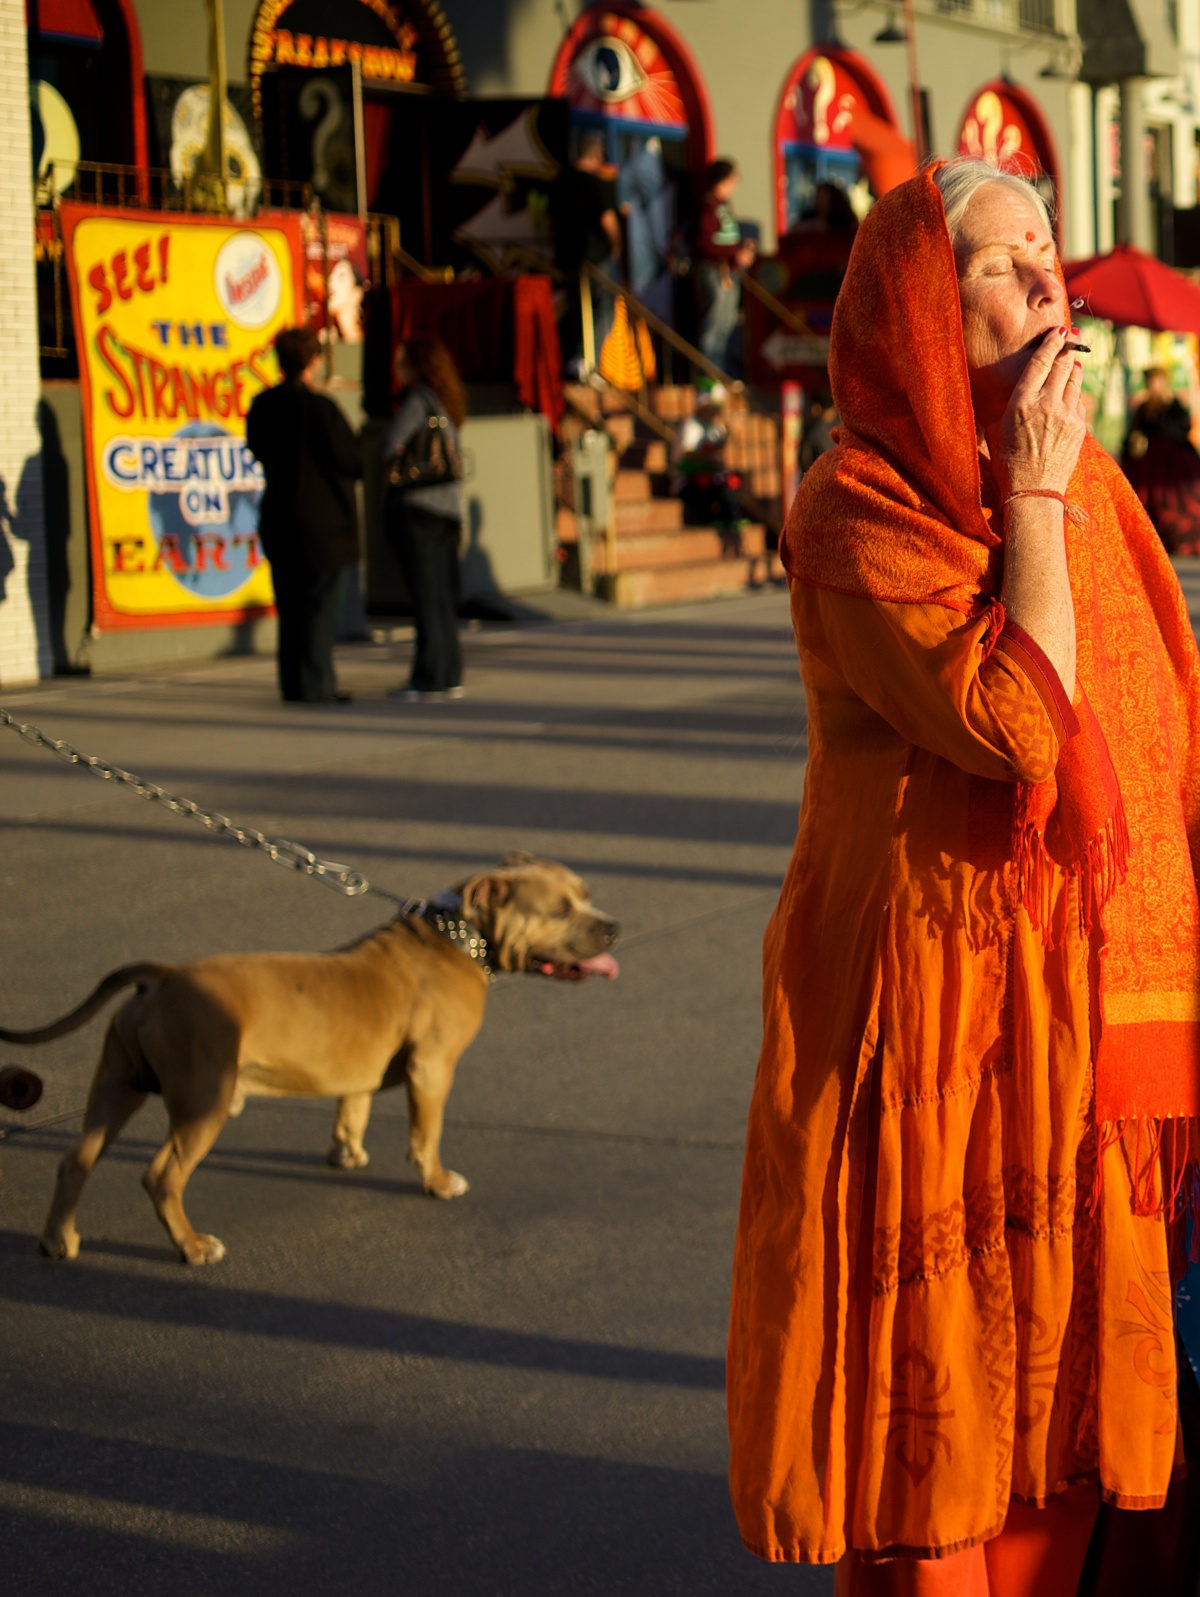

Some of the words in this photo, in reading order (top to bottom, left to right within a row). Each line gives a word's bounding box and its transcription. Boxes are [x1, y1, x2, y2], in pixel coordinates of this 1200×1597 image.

[88, 234, 169, 316] SEE!
[151, 321, 228, 347] THE
[95, 324, 287, 418] STRANGES
[109, 445, 263, 481] CREATUR
[186, 490, 222, 513] ON
[107, 532, 262, 573] EART
